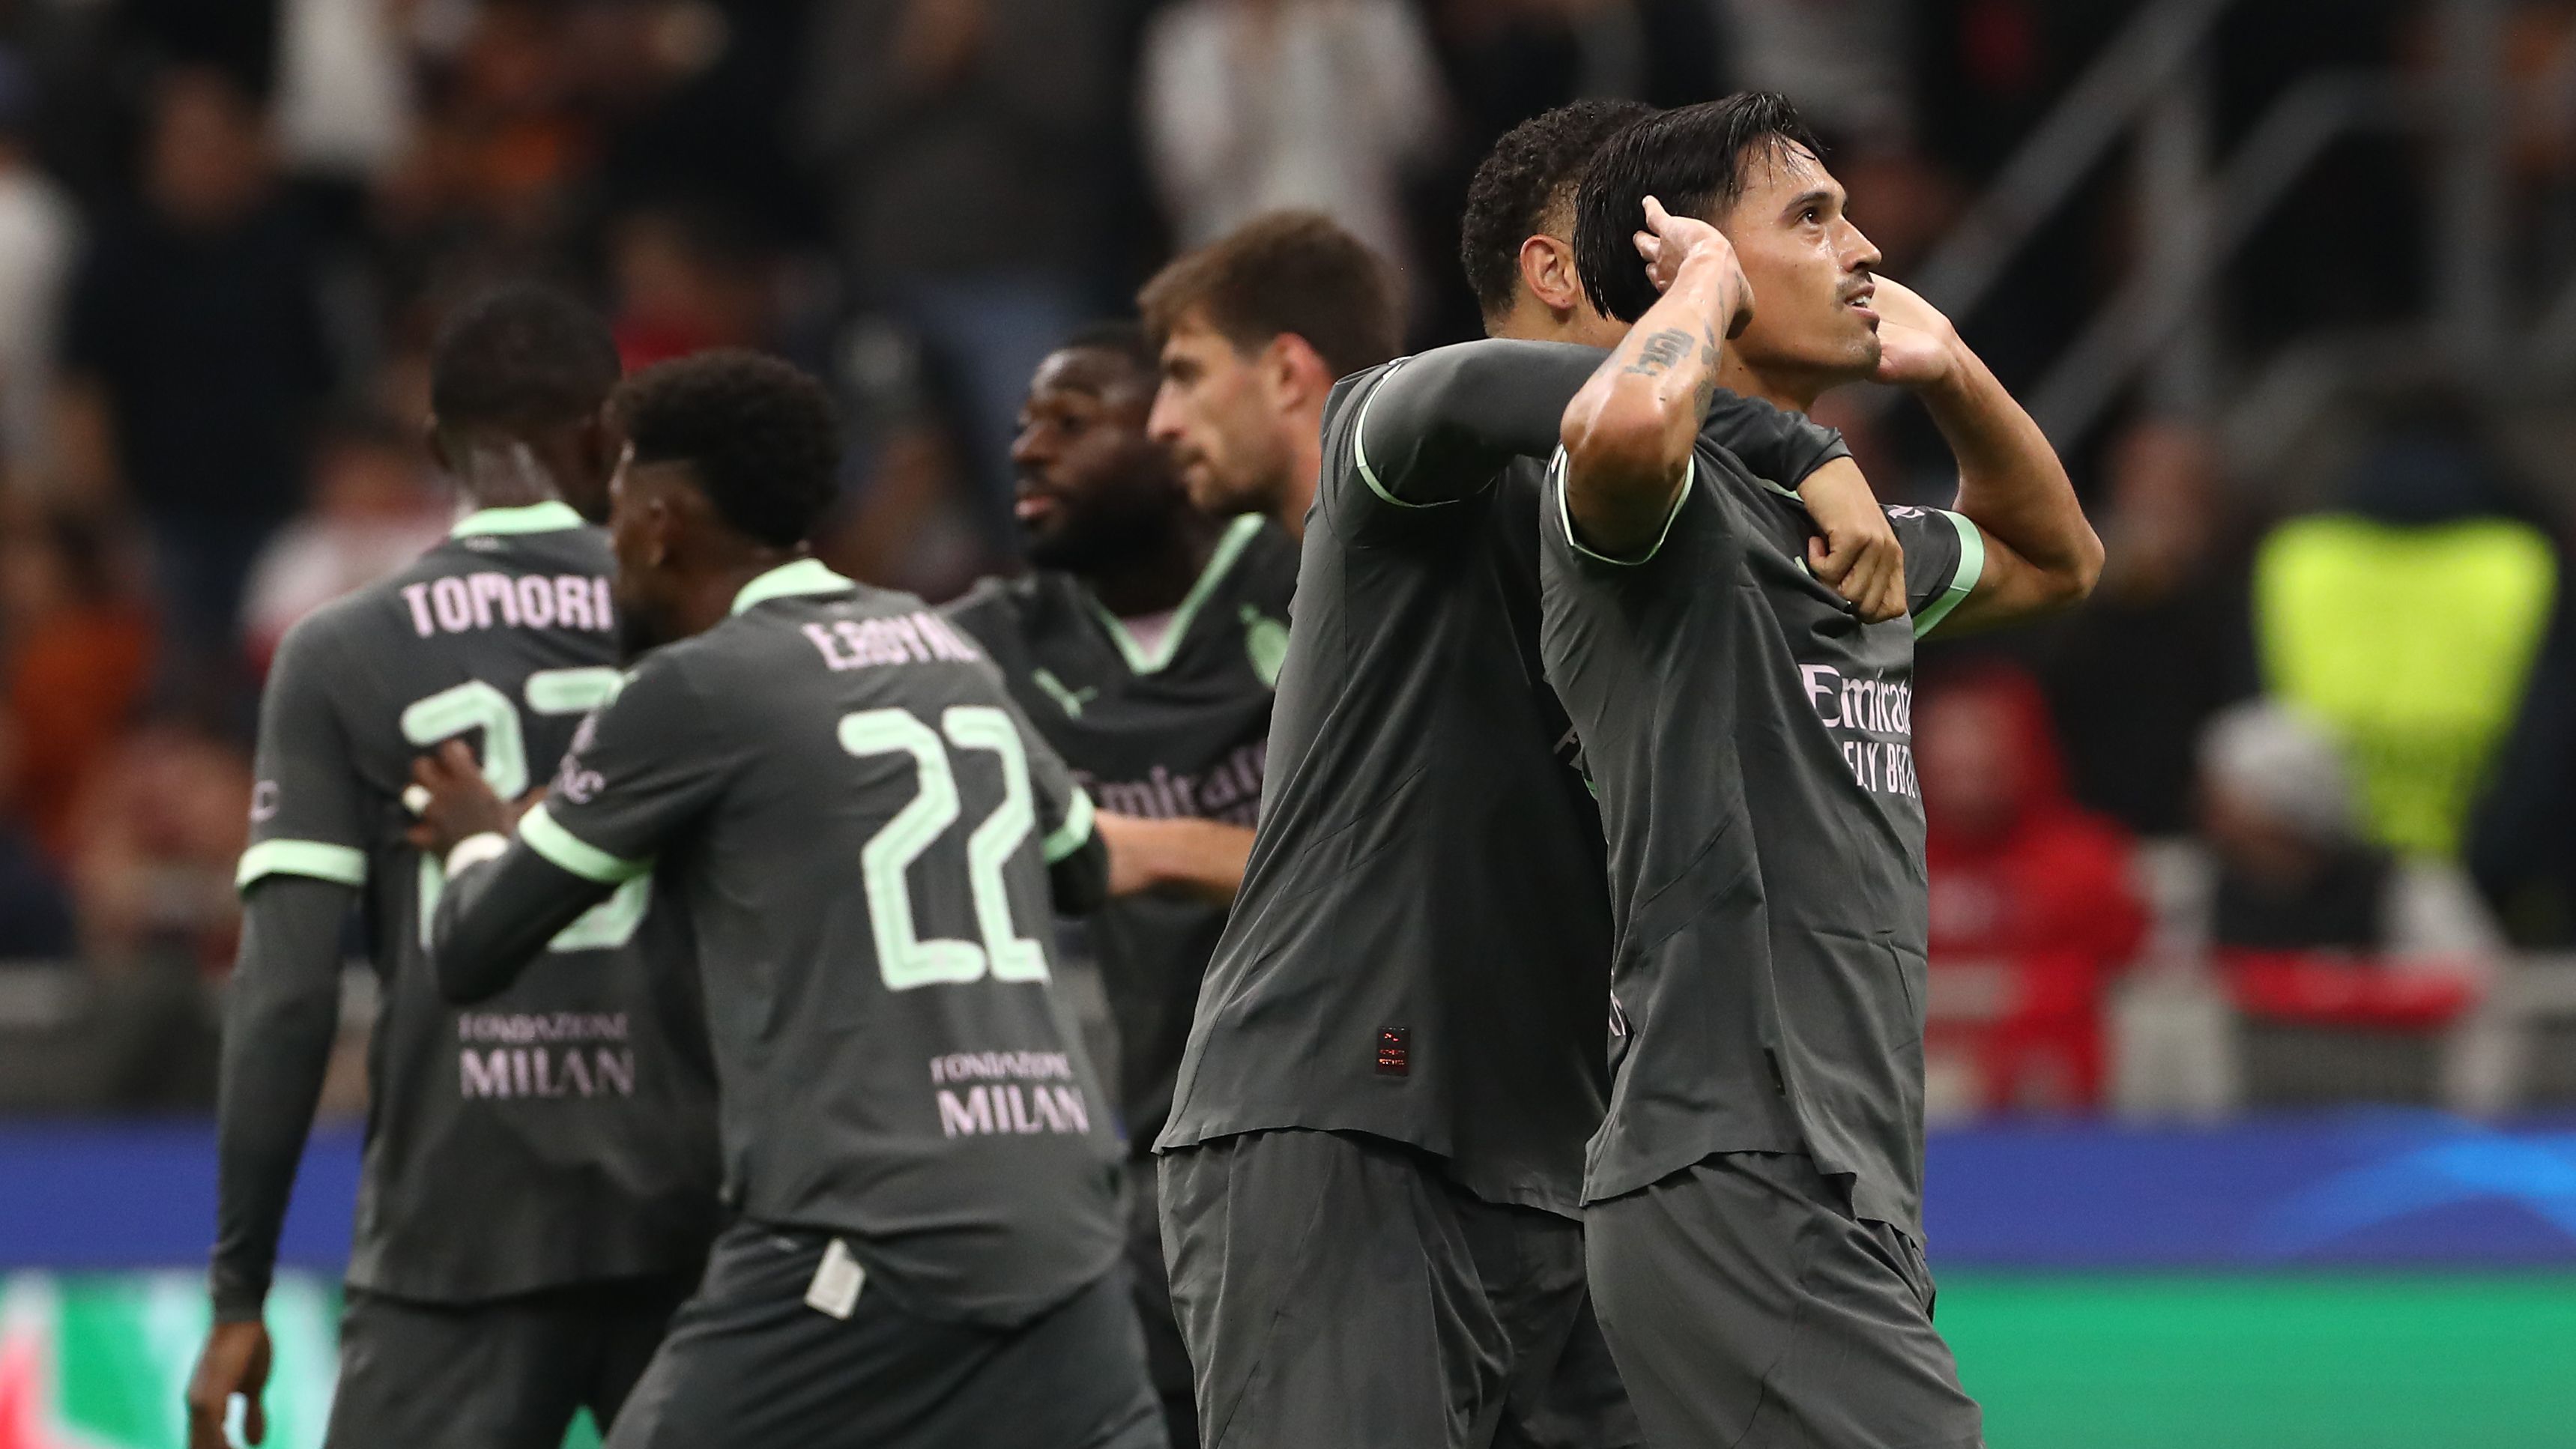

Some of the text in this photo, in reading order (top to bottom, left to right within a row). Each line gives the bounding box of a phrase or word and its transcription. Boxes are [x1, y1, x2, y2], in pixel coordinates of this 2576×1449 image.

[401, 572, 614, 638] TOMORI
[838, 706, 1050, 990] 22
[460, 1047, 635, 1098] MILAN
[937, 1085, 1090, 1139] MILAN
